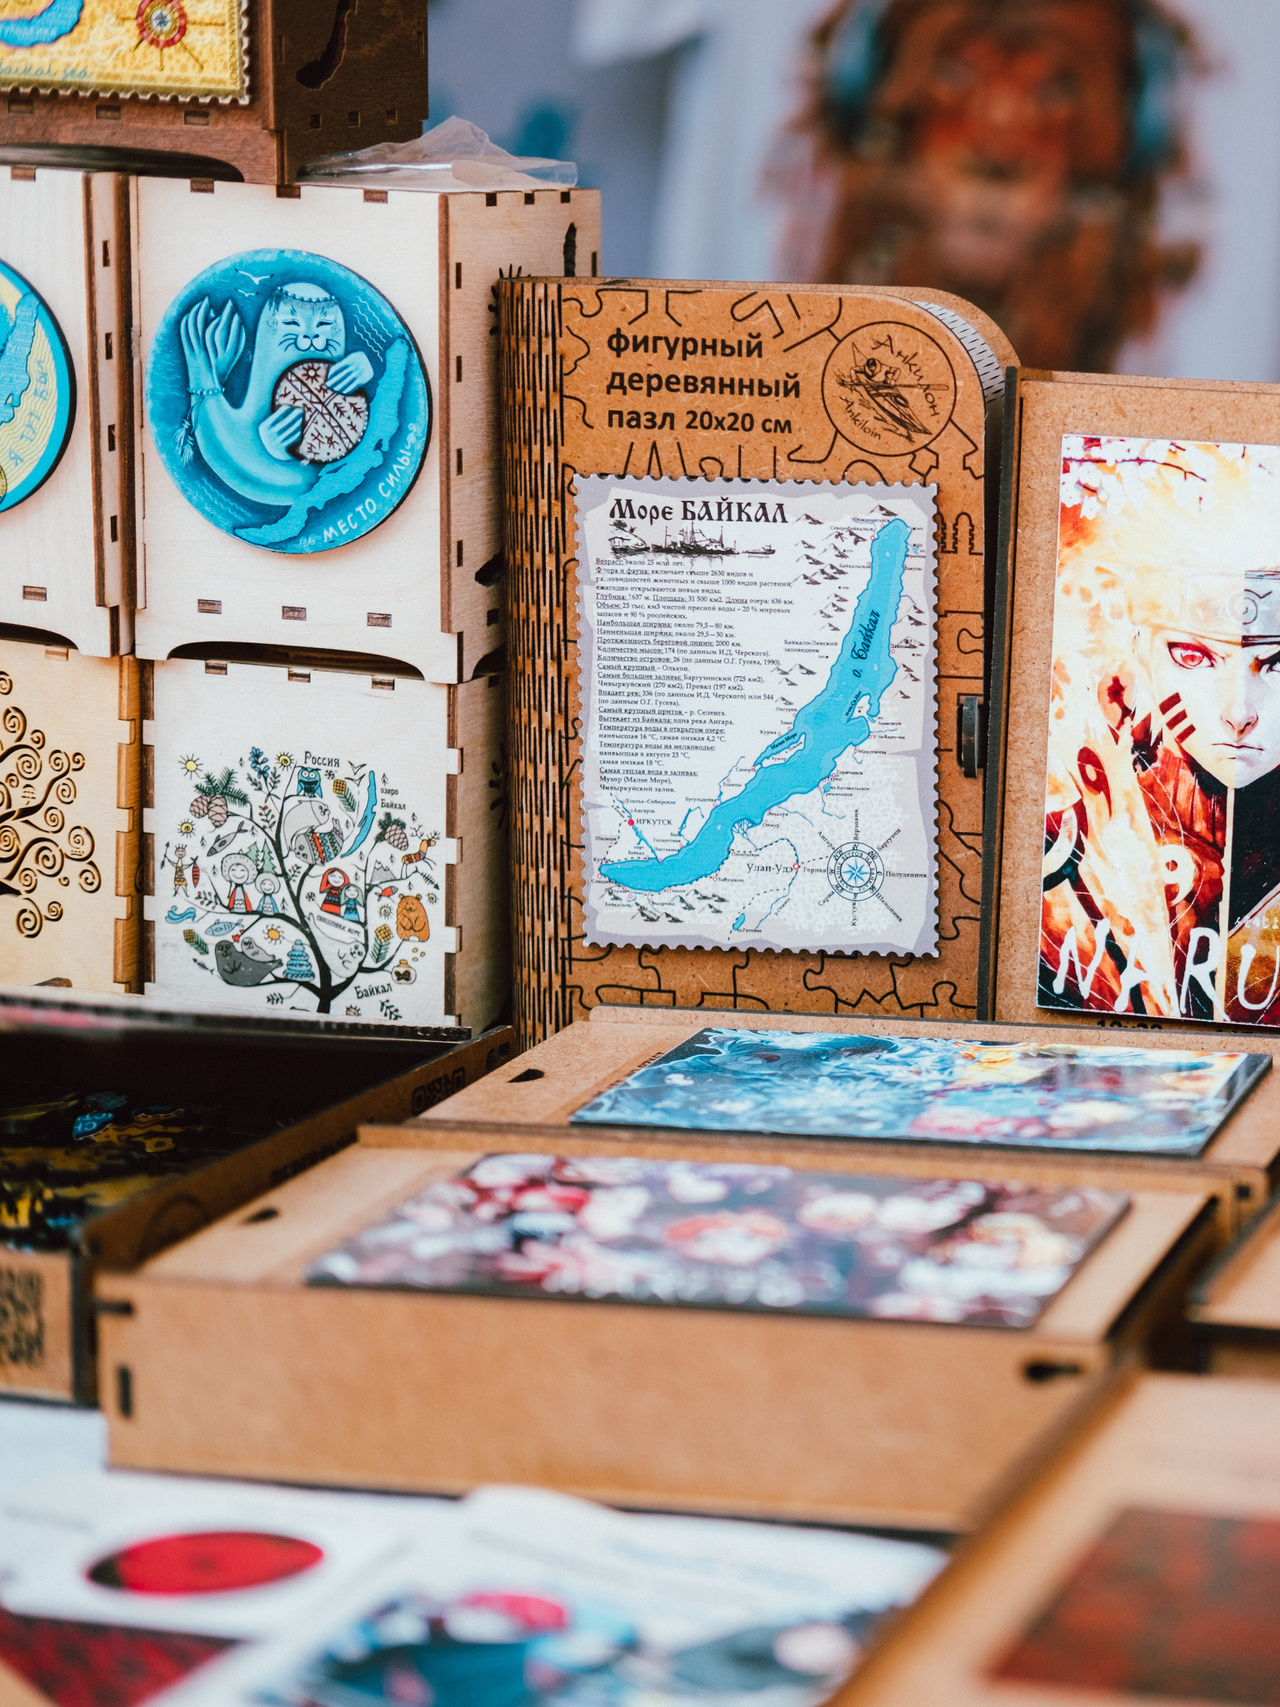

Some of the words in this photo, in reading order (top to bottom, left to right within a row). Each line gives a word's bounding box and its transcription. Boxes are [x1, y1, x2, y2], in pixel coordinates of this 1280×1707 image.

[606, 327, 763, 361] фигурный
[606, 371, 801, 399] деревянный
[8, 448, 24, 467] Я
[20, 411, 42, 443] ТУТ
[33, 359, 49, 401] БЫЛ
[607, 409, 676, 431] пазл
[761, 416, 793, 435] см
[323, 498, 377, 543] МЕСТО
[378, 449, 412, 498] СИЛЫ
[608, 498, 673, 525] Море
[680, 496, 789, 524] БАЙКАЛ
[630, 586, 676, 594] открываются
[598, 723, 642, 733] Температура
[598, 740, 642, 750] Температура
[303, 750, 340, 768] Россия
[380, 786, 399, 797] озеро
[380, 798, 406, 810] Байкал
[746, 863, 794, 874] Улан-Удэ
[354, 982, 393, 1000] Байкал
